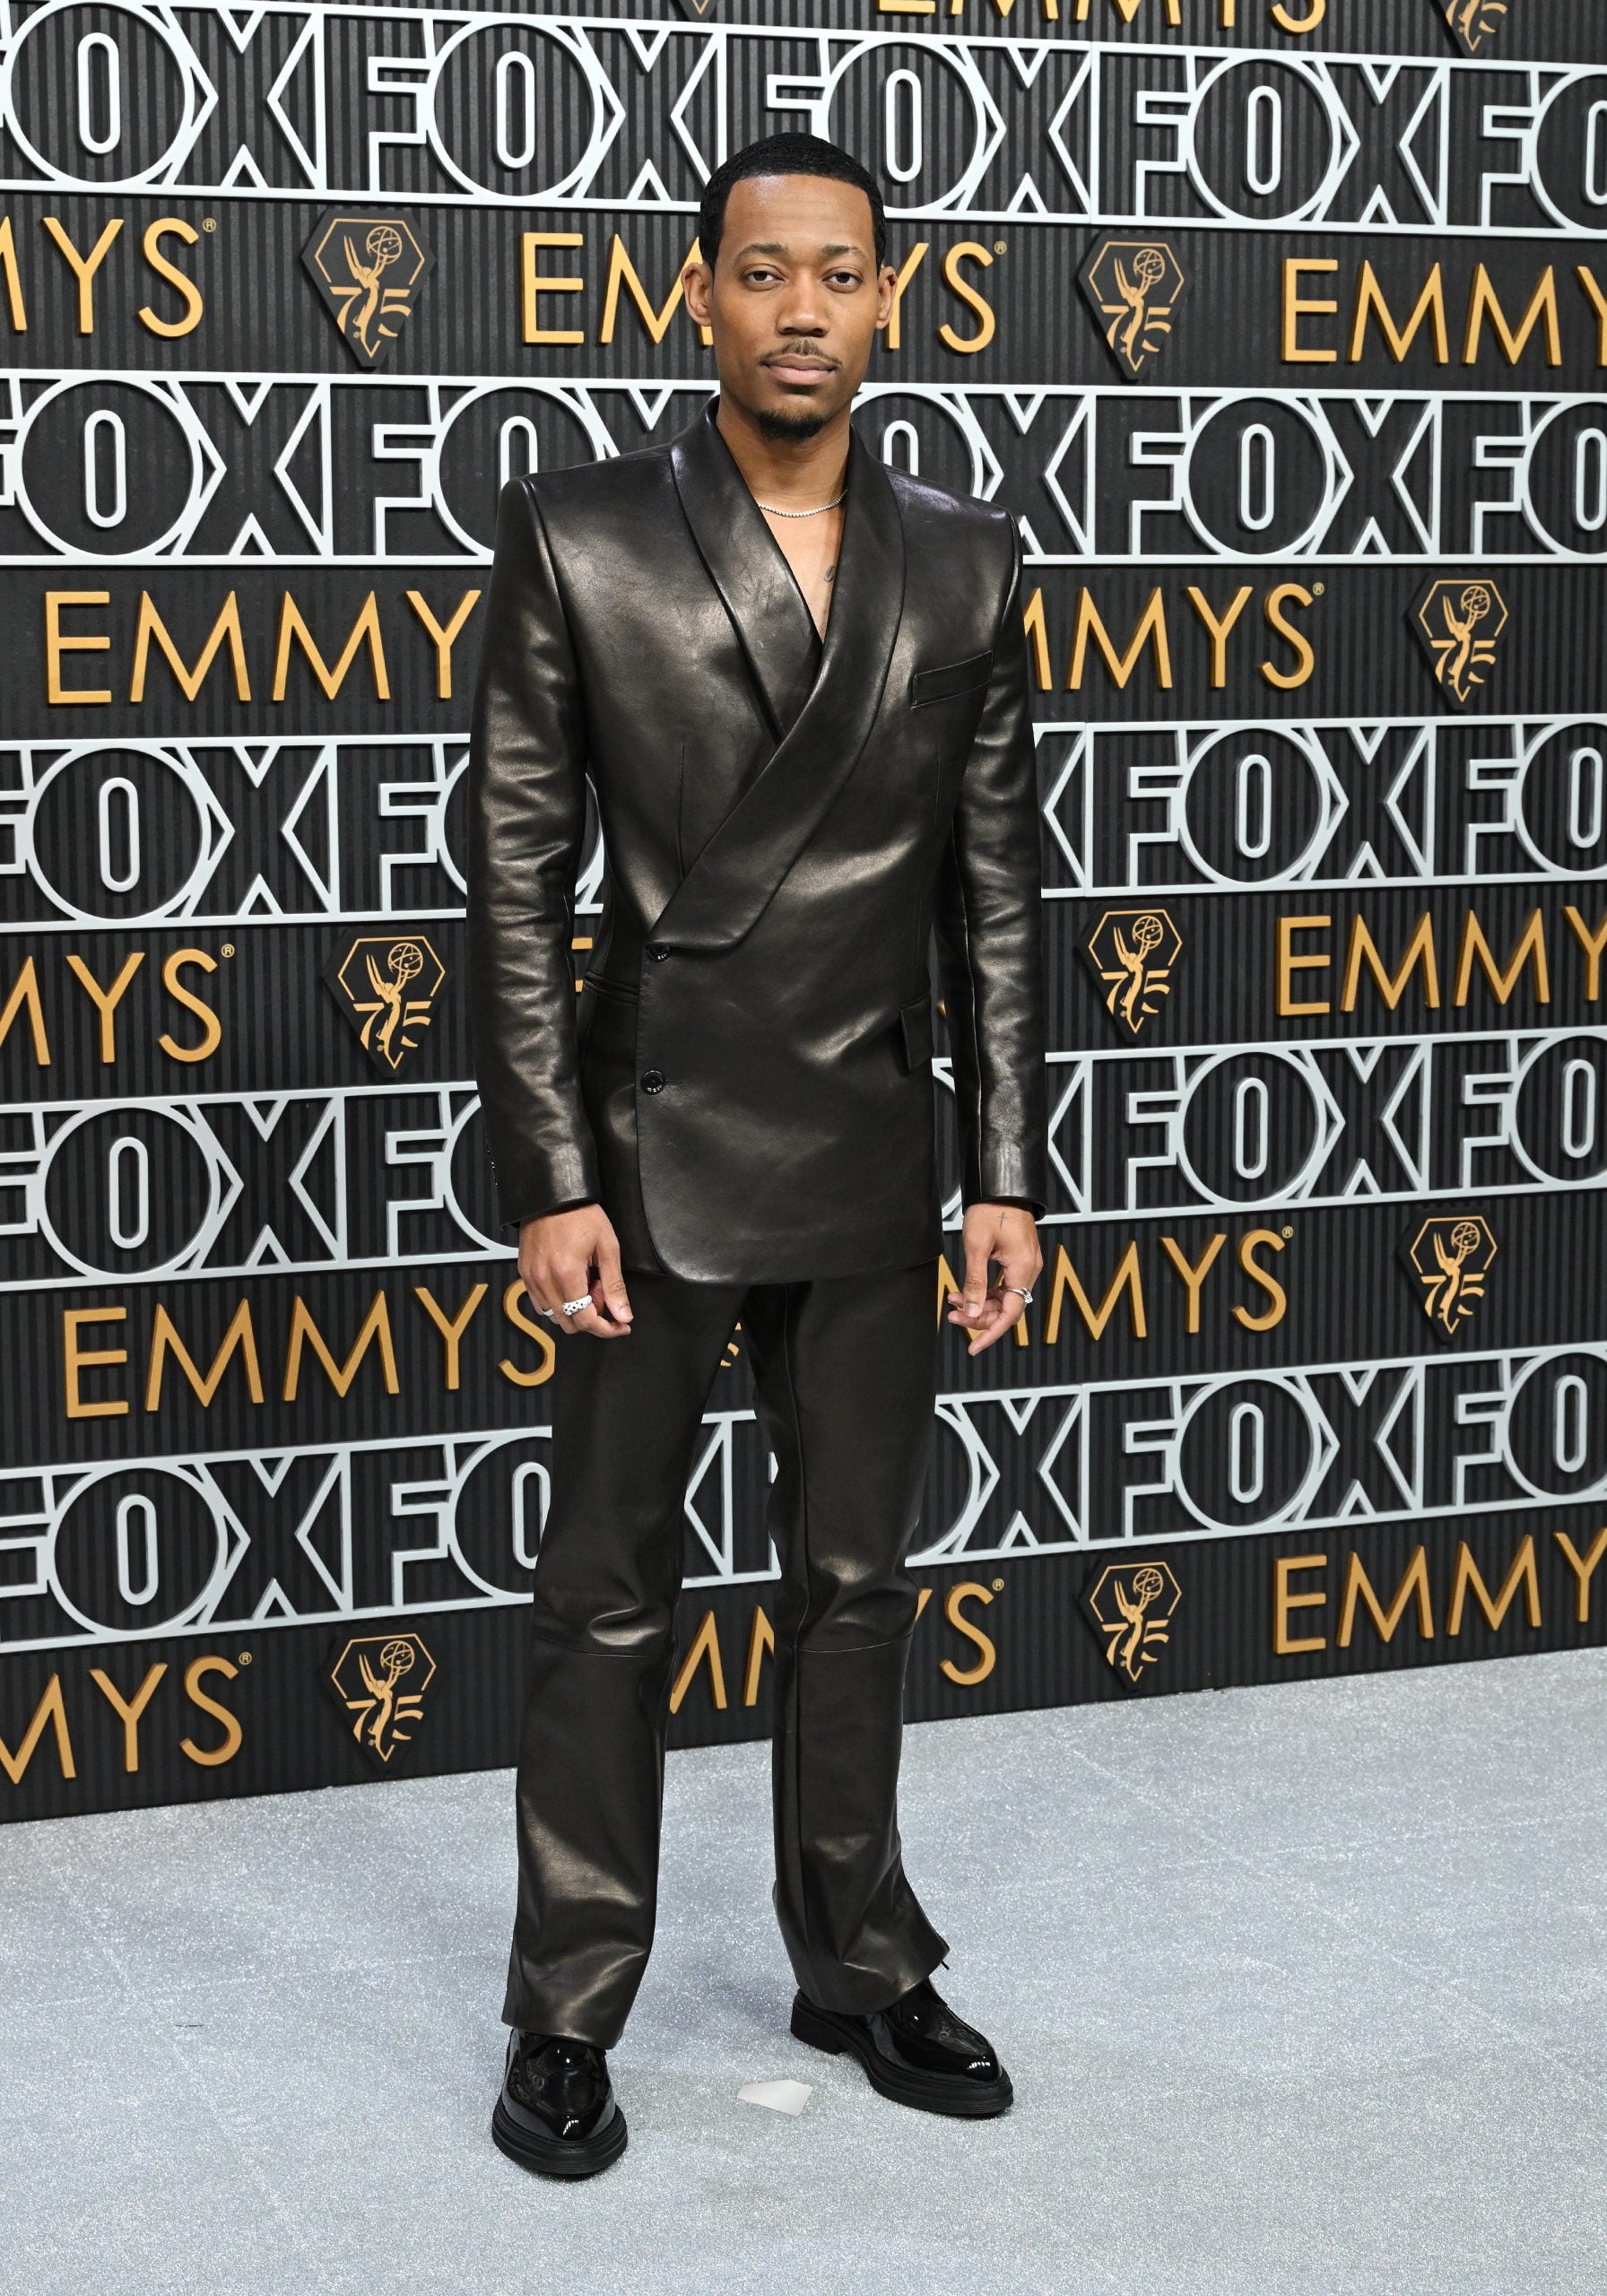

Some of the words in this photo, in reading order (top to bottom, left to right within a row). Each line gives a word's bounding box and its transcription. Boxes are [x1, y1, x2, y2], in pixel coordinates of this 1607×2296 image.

[0, 0, 326, 204] OX
[315, 8, 727, 211] FOX
[1086, 40, 1450, 235] FOX
[0, 369, 333, 566] OX
[1086, 386, 1443, 564] FOX
[0, 734, 339, 933] OX
[1083, 719, 1437, 897] FOX
[1081, 1039, 1433, 1220] FOX
[1080, 1357, 1425, 1551] FOX
